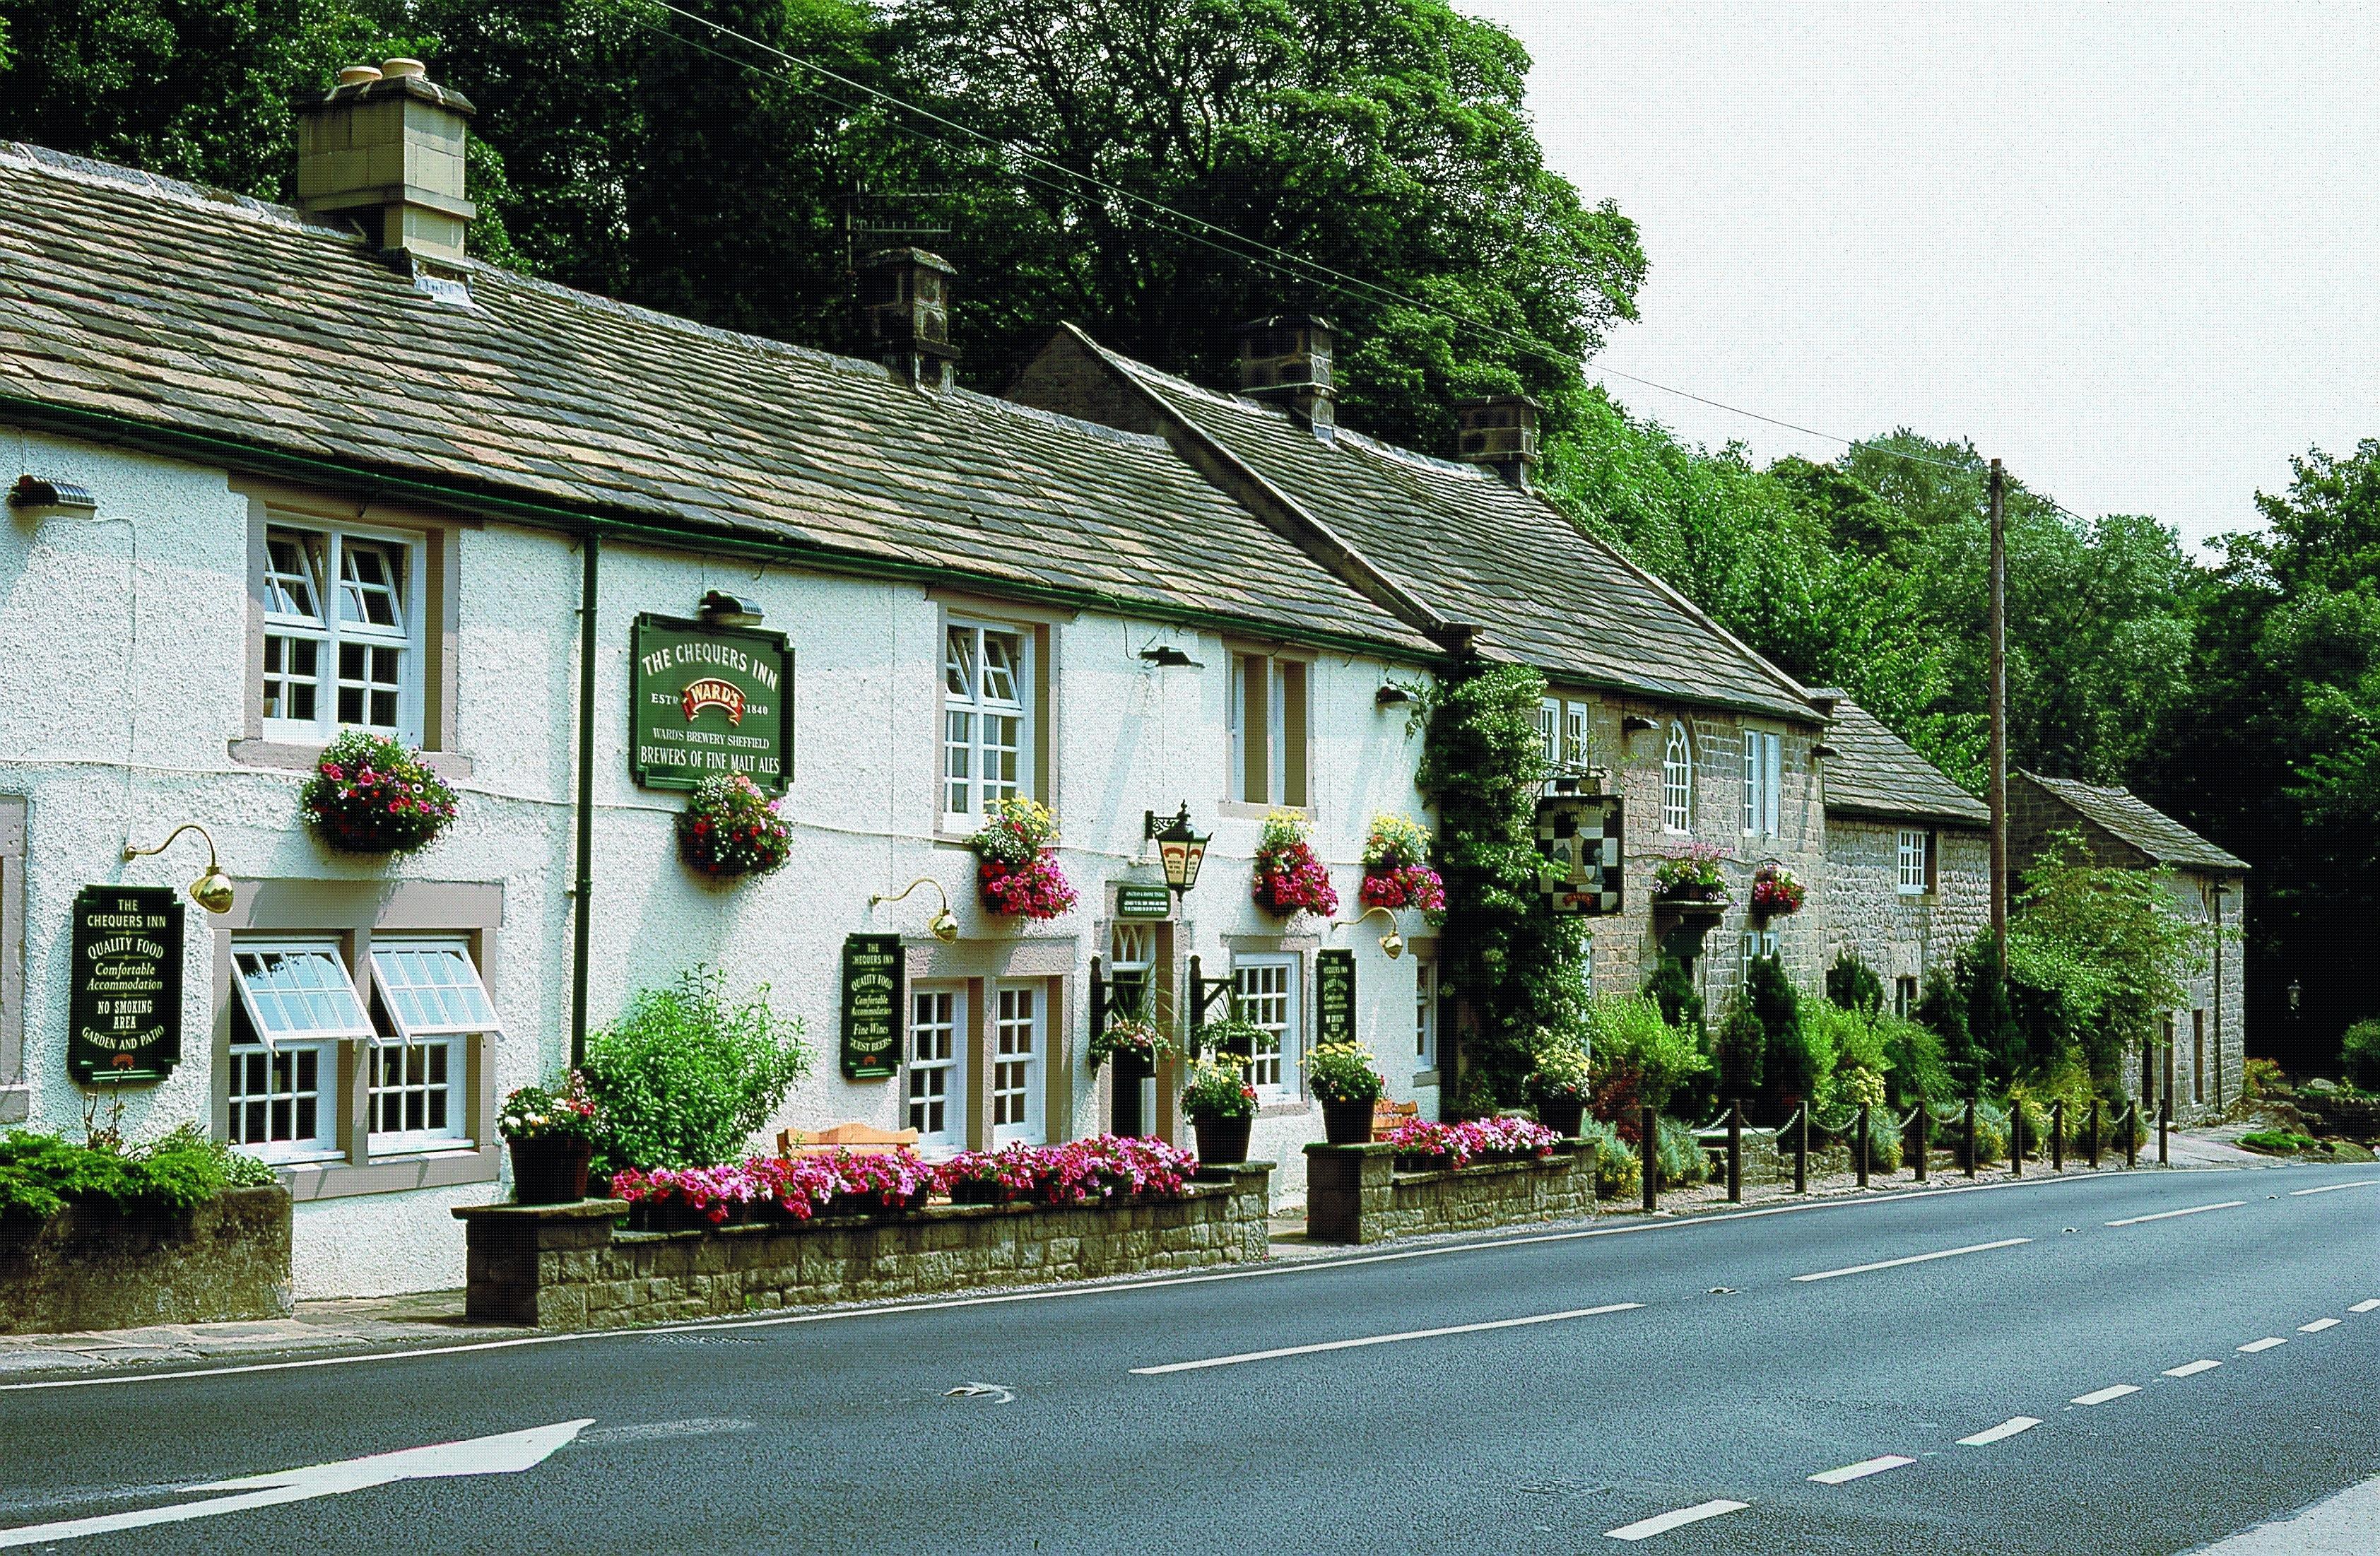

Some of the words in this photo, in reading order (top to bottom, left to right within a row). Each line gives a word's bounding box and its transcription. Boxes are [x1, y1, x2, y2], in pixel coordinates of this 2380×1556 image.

[642, 648, 672, 676] THE
[676, 643, 748, 672] CHEQUERS
[753, 659, 778, 692] INN
[690, 683, 740, 708] WARD'S
[746, 705, 768, 715] 1840
[653, 727, 684, 741] WARD'S
[686, 731, 725, 745] BREWERY
[728, 735, 769, 749] SHEFFIELD
[641, 745, 686, 766] BREWERS
[690, 751, 703, 767] OF
[707, 752, 726, 769] FINE
[731, 754, 755, 772] MALT
[759, 758, 779, 774] ALES
[117, 899, 138, 912] THE
[87, 914, 142, 928] CHEQUERS
[147, 915, 166, 928] INN
[88, 937, 132, 960] QUALITY
[137, 938, 164, 959] FOOD
[868, 943, 879, 953] THE
[852, 955, 882, 965] HEQUERS
[883, 955, 894, 965] INN
[95, 962, 155, 979] Comfortable
[86, 977, 163, 991] Accommodation
[852, 974, 876, 991] QUALITY
[878, 974, 893, 990] FOOD
[98, 1001, 110, 1015] NO
[114, 1000, 152, 1014] SMOKING
[113, 1015, 136, 1030] AREA
[854, 1022, 868, 1035] Fine
[870, 1022, 889, 1034] Wines
[82, 1025, 116, 1050] GARDEN
[119, 1037, 137, 1051] AND
[141, 1025, 165, 1047] PATIO
[871, 1035, 892, 1051] BEERS
